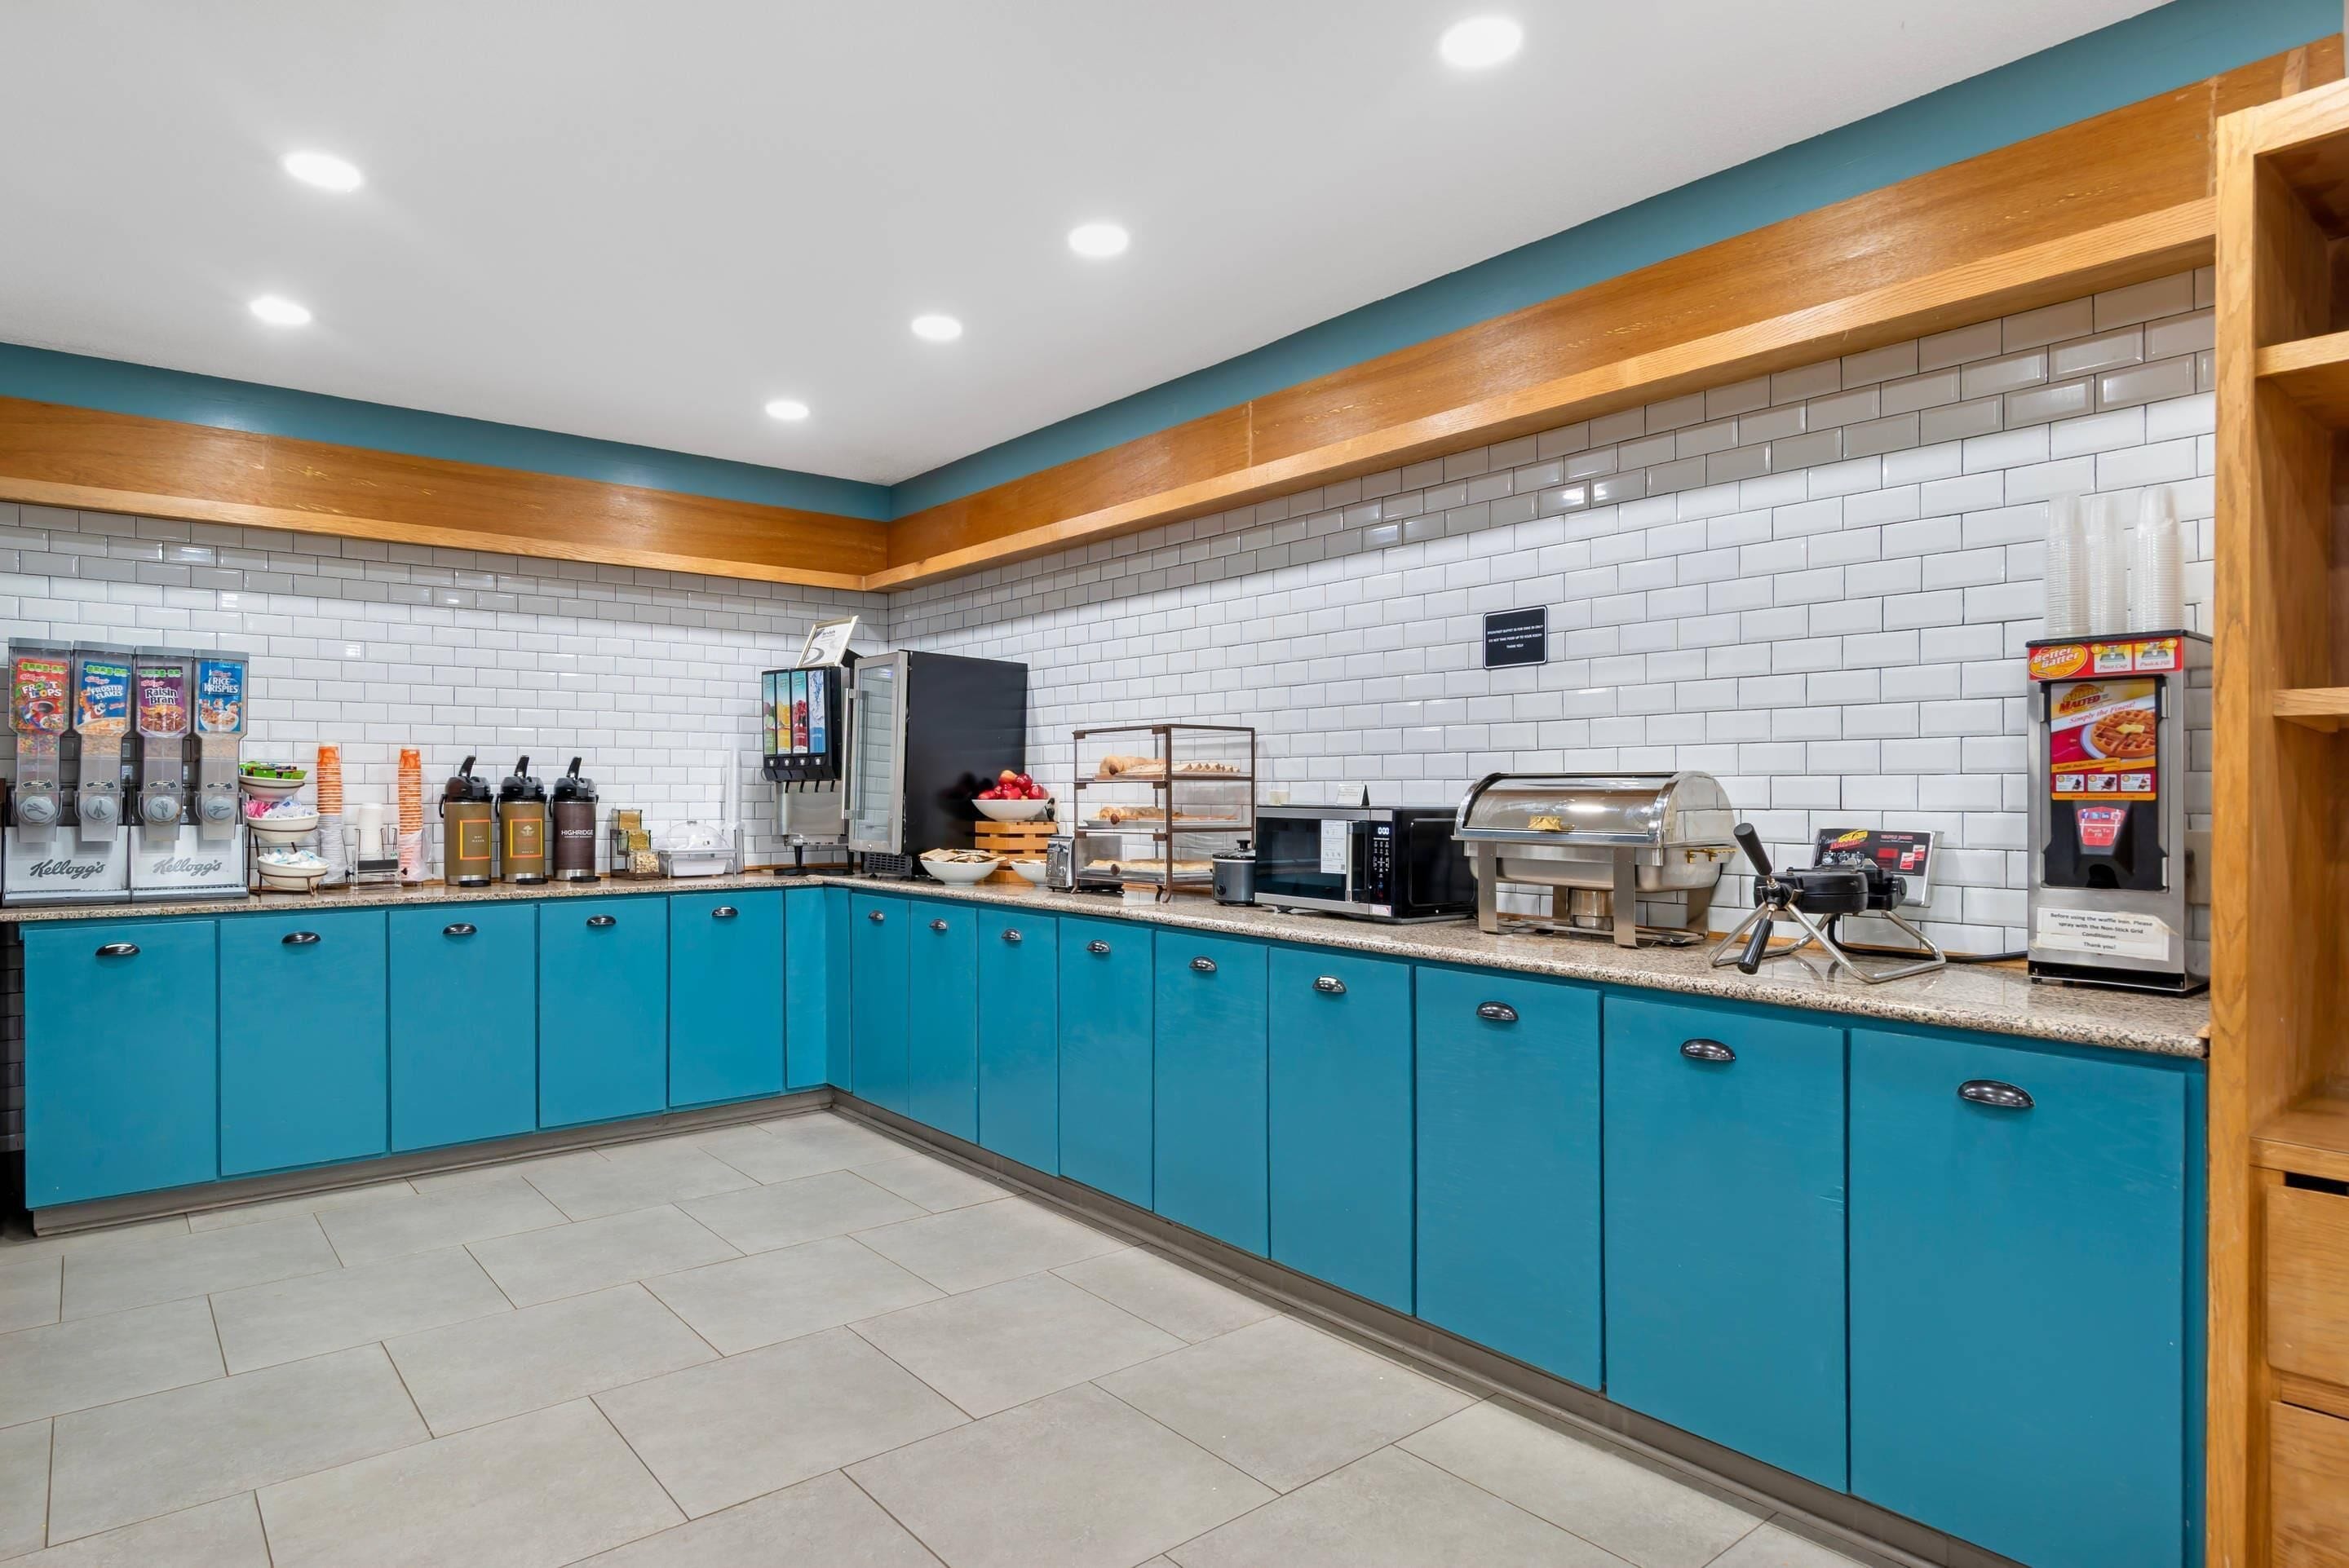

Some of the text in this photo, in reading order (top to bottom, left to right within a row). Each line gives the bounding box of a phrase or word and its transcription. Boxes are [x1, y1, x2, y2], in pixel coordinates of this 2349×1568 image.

[2033, 647, 2072, 665] Better
[2042, 652, 2079, 669] Batter
[212, 677, 230, 686] RICE
[91, 685, 122, 695] FROSTED
[95, 690, 122, 700] FLAKES
[145, 687, 178, 699] Raisin
[203, 684, 239, 693] KRISPIES
[149, 696, 176, 705] Bran
[2059, 695, 2101, 712] MALTED
[2068, 711, 2095, 724] Simply
[2096, 709, 2108, 717] the
[29, 859, 106, 879] Kellogg's
[153, 858, 222, 877] Kellogg's
